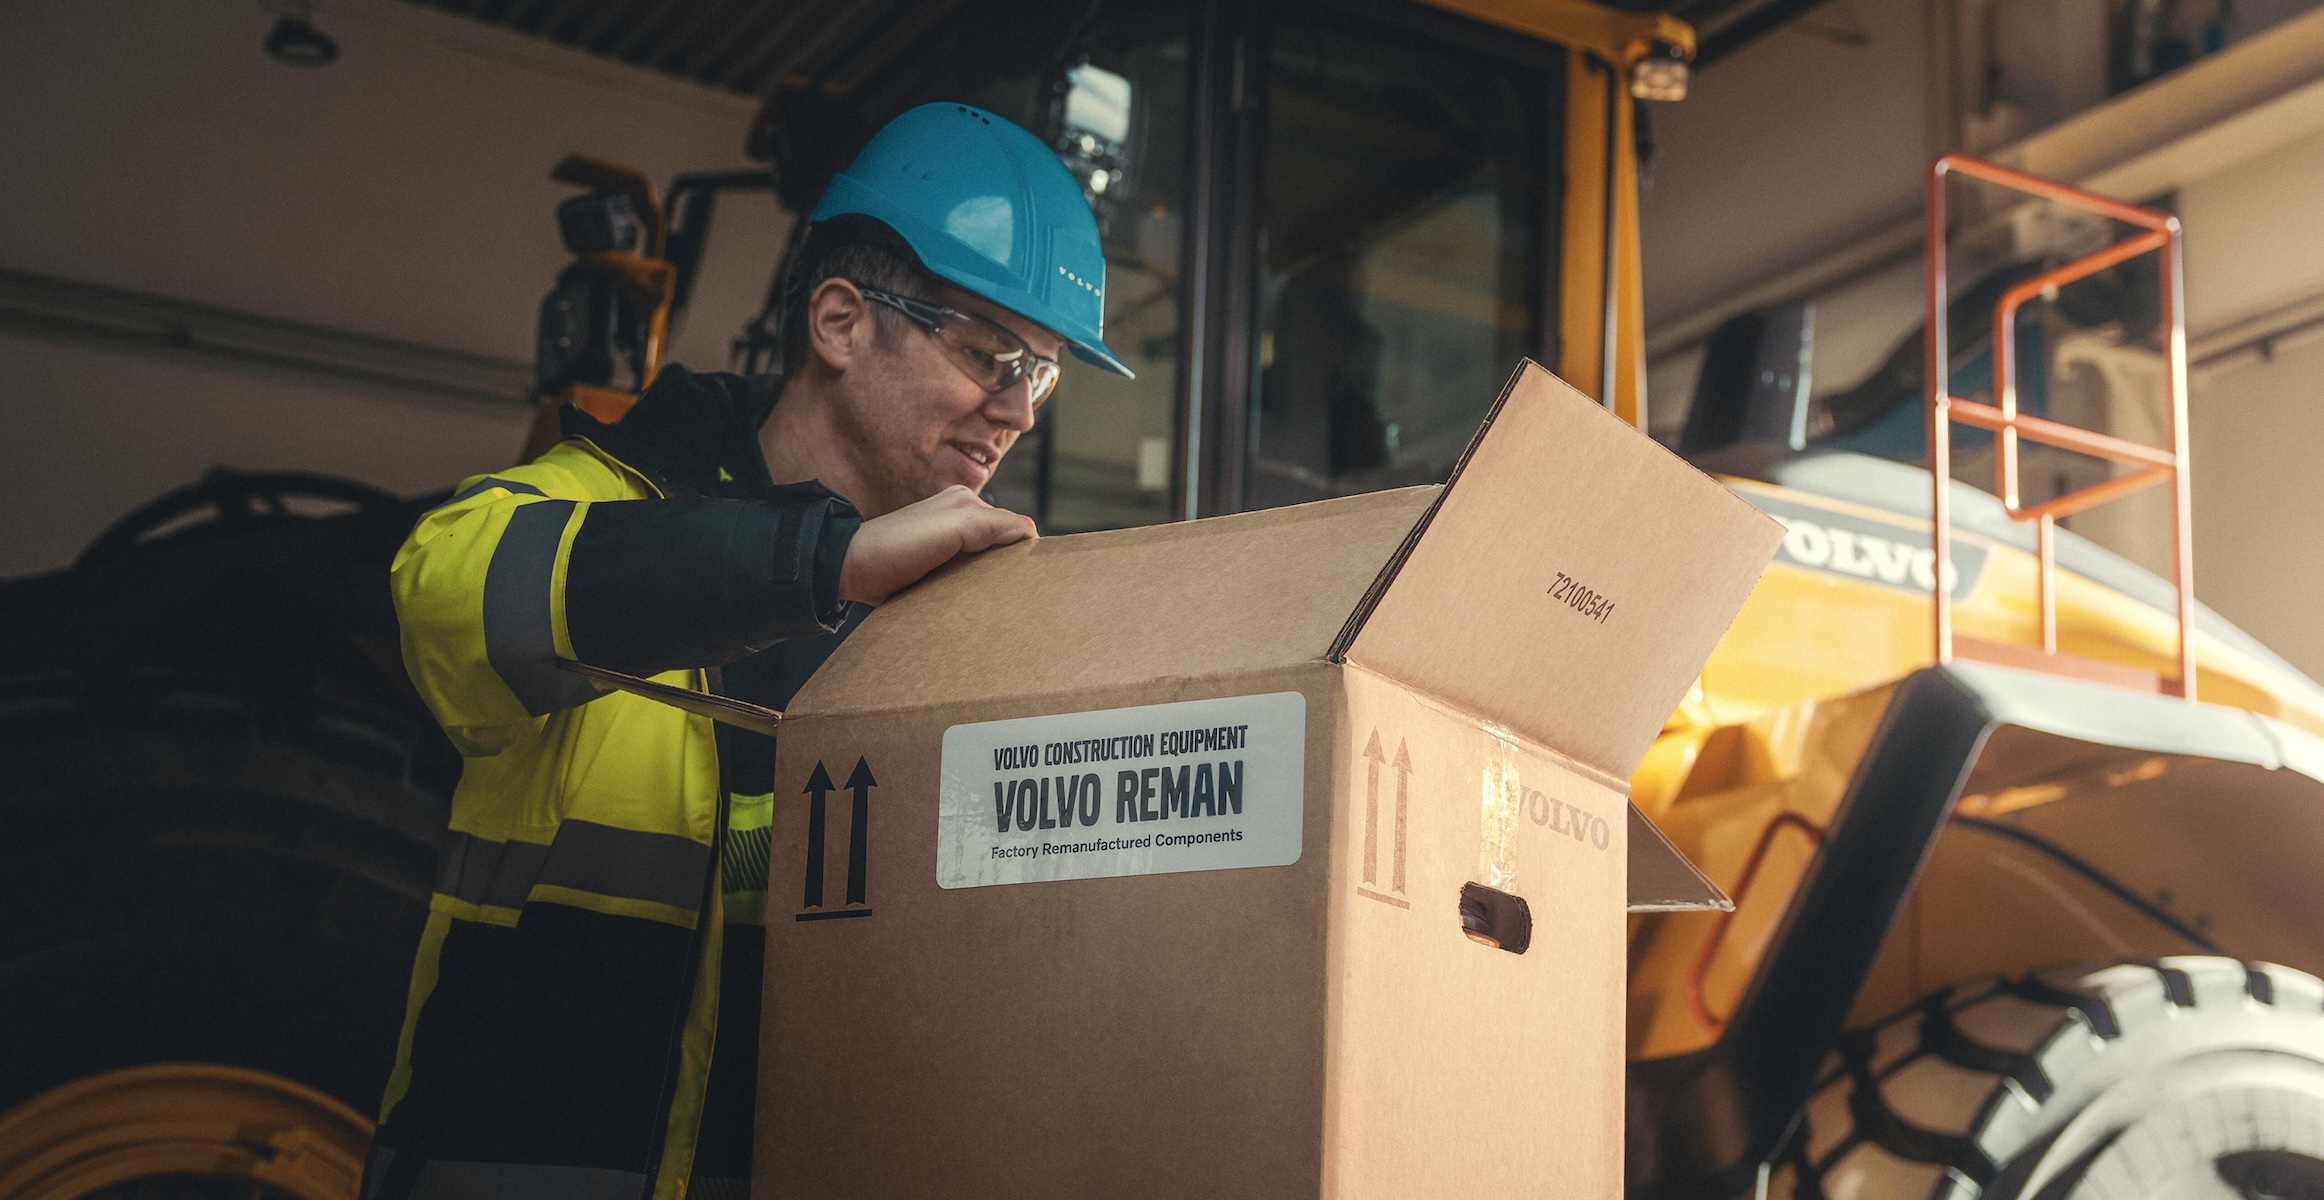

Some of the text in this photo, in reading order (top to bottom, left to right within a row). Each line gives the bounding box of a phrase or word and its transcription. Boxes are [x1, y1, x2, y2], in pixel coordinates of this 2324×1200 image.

[1058, 265, 1101, 297] VOLVO
[1770, 513, 1959, 592] OLVO
[1546, 571, 1616, 625] 72100541
[994, 725, 1248, 771] VOLVO CONSTRUCTION EQUIPMENT
[994, 761, 1244, 832] VOLVO REMAN
[991, 829, 1243, 860] Factory Remanufactured Components
